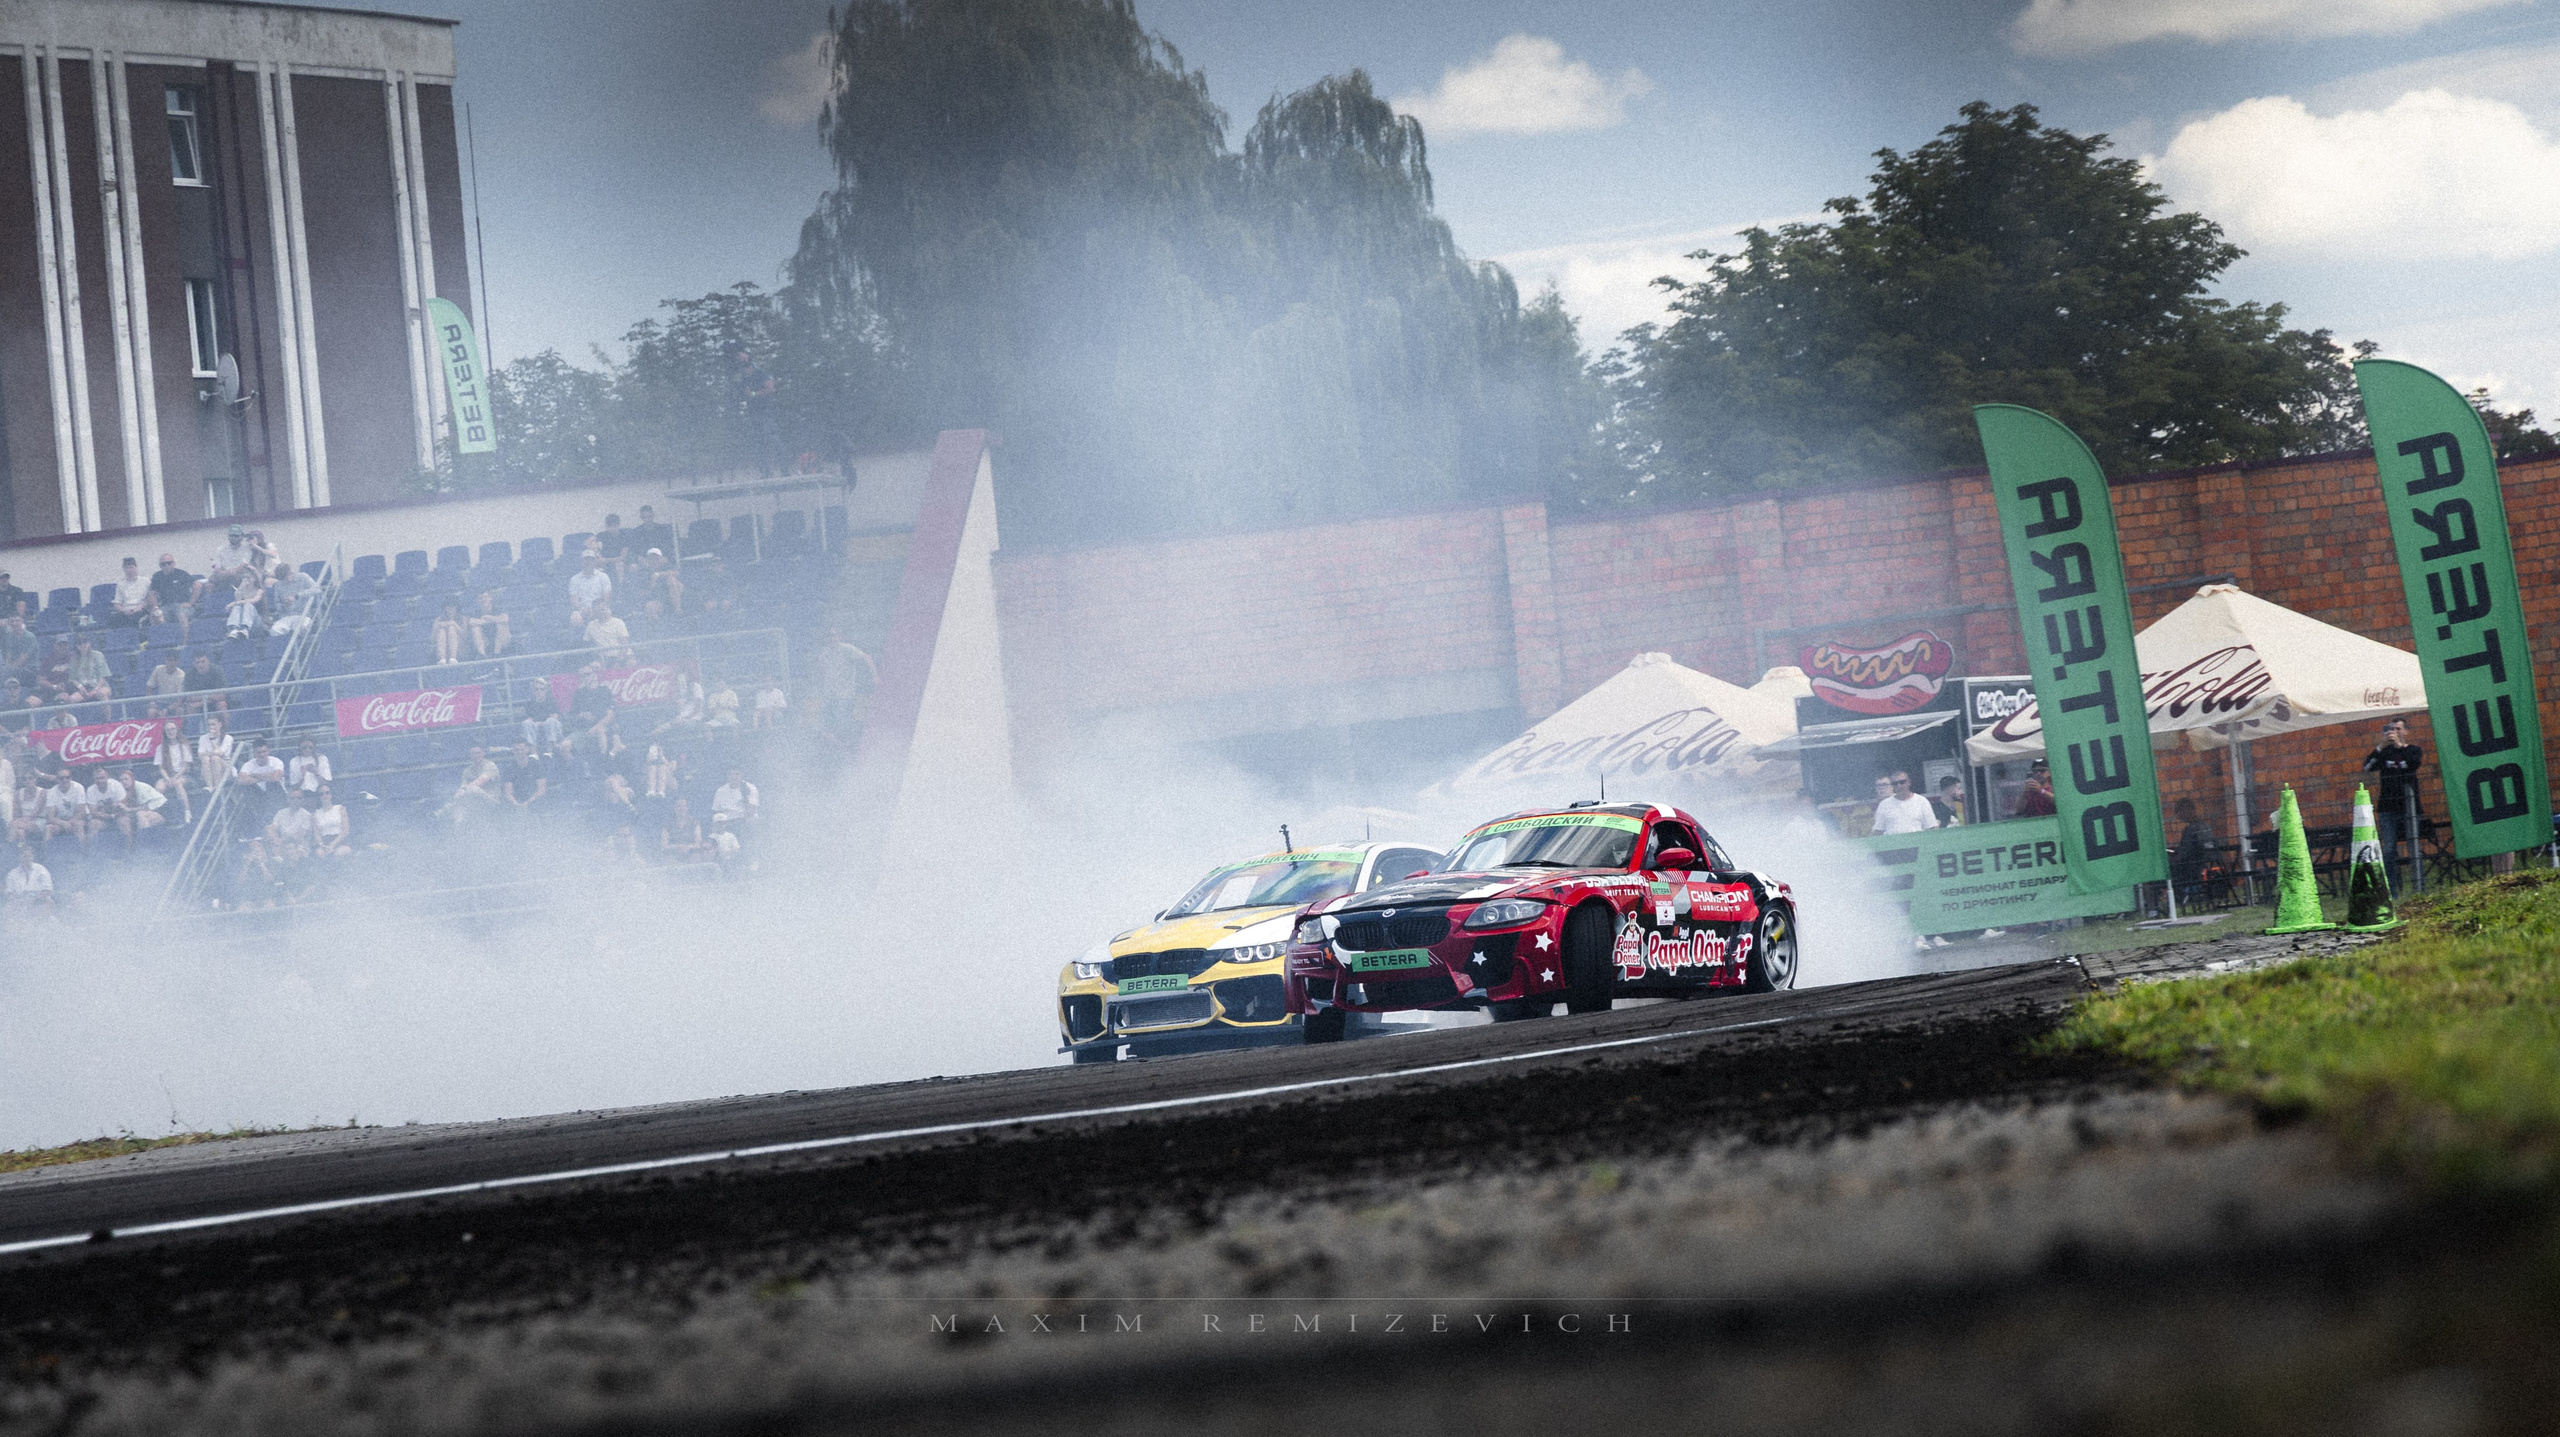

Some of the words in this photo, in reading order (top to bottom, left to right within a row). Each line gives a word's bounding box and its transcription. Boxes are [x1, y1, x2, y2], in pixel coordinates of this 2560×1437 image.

[361, 690, 457, 730] Coca-Cola
[60, 722, 158, 762] Coca-Cola
[1604, 889, 1621, 897] DRIFT
[1940, 881, 2016, 898] ЧЕМПИОНАТ
[2019, 874, 2068, 889] БЕЛАРУ
[1690, 889, 1749, 904] CHAMPION
[1942, 902, 1959, 912] ПО
[1963, 892, 2037, 911] ДРИФТИНГУ
[1700, 904, 1741, 912] LUBRICANTS
[1616, 936, 1639, 949] Papa
[1613, 951, 1641, 965] Döner
[1648, 931, 1692, 976] Papa
